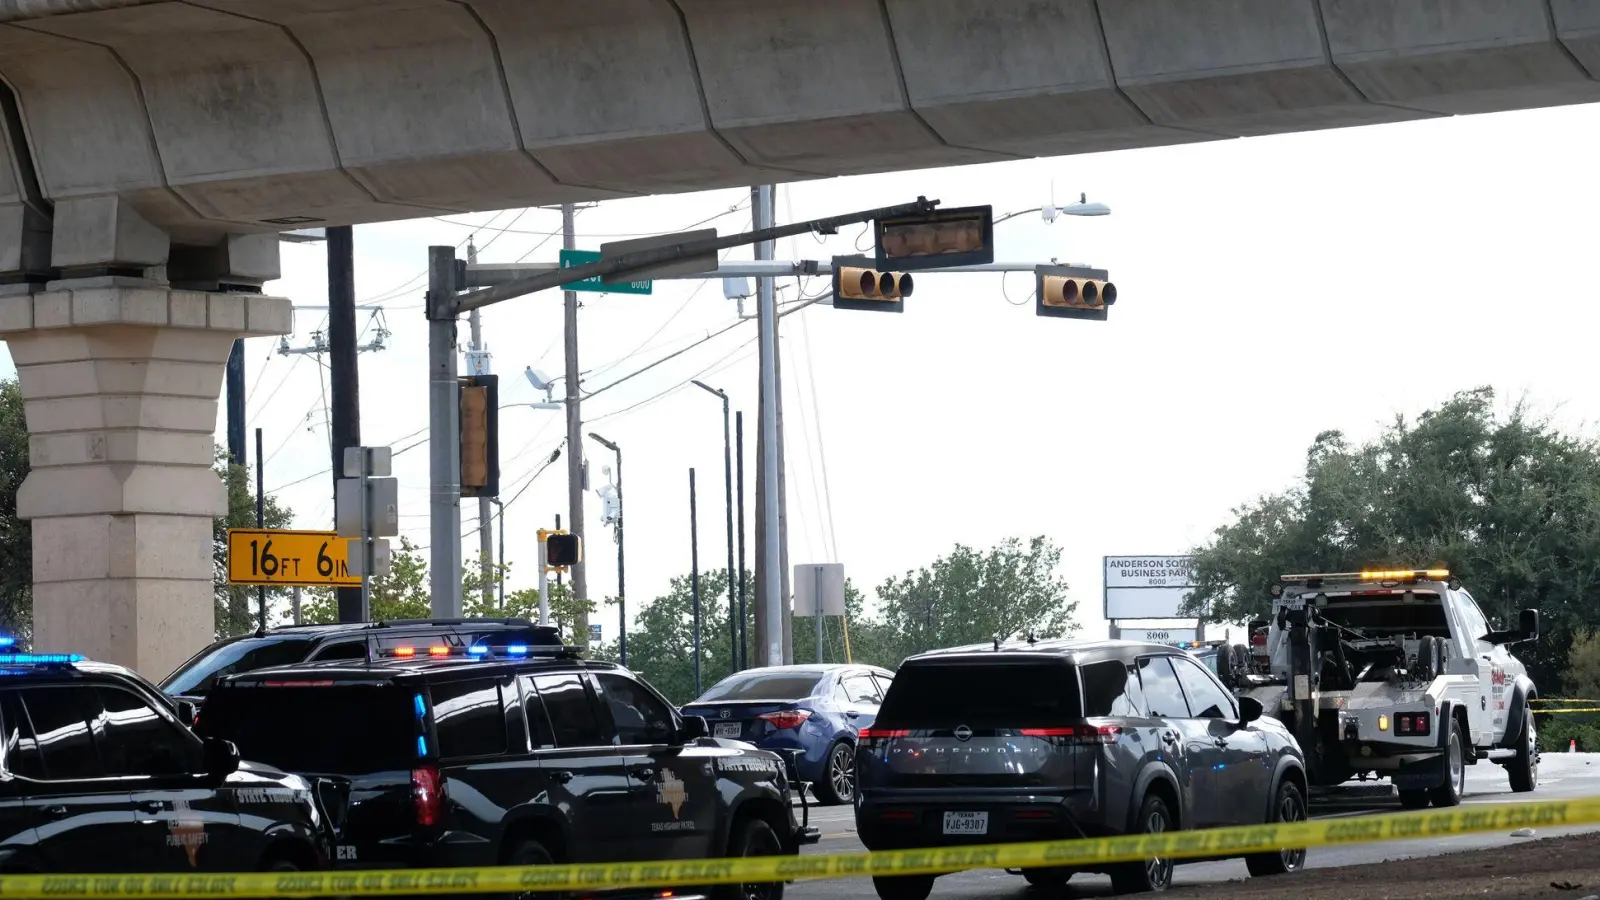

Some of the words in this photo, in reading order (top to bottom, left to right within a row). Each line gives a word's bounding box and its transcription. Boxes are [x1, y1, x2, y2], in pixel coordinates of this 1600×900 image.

[1110, 559, 1164, 568] ANDERSON
[1121, 569, 1166, 577] BUSINESS
[1146, 631, 1169, 640] 8000
[717, 757, 743, 772] STATE
[236, 787, 267, 803] STATE
[680, 819, 696, 831] PATROL
